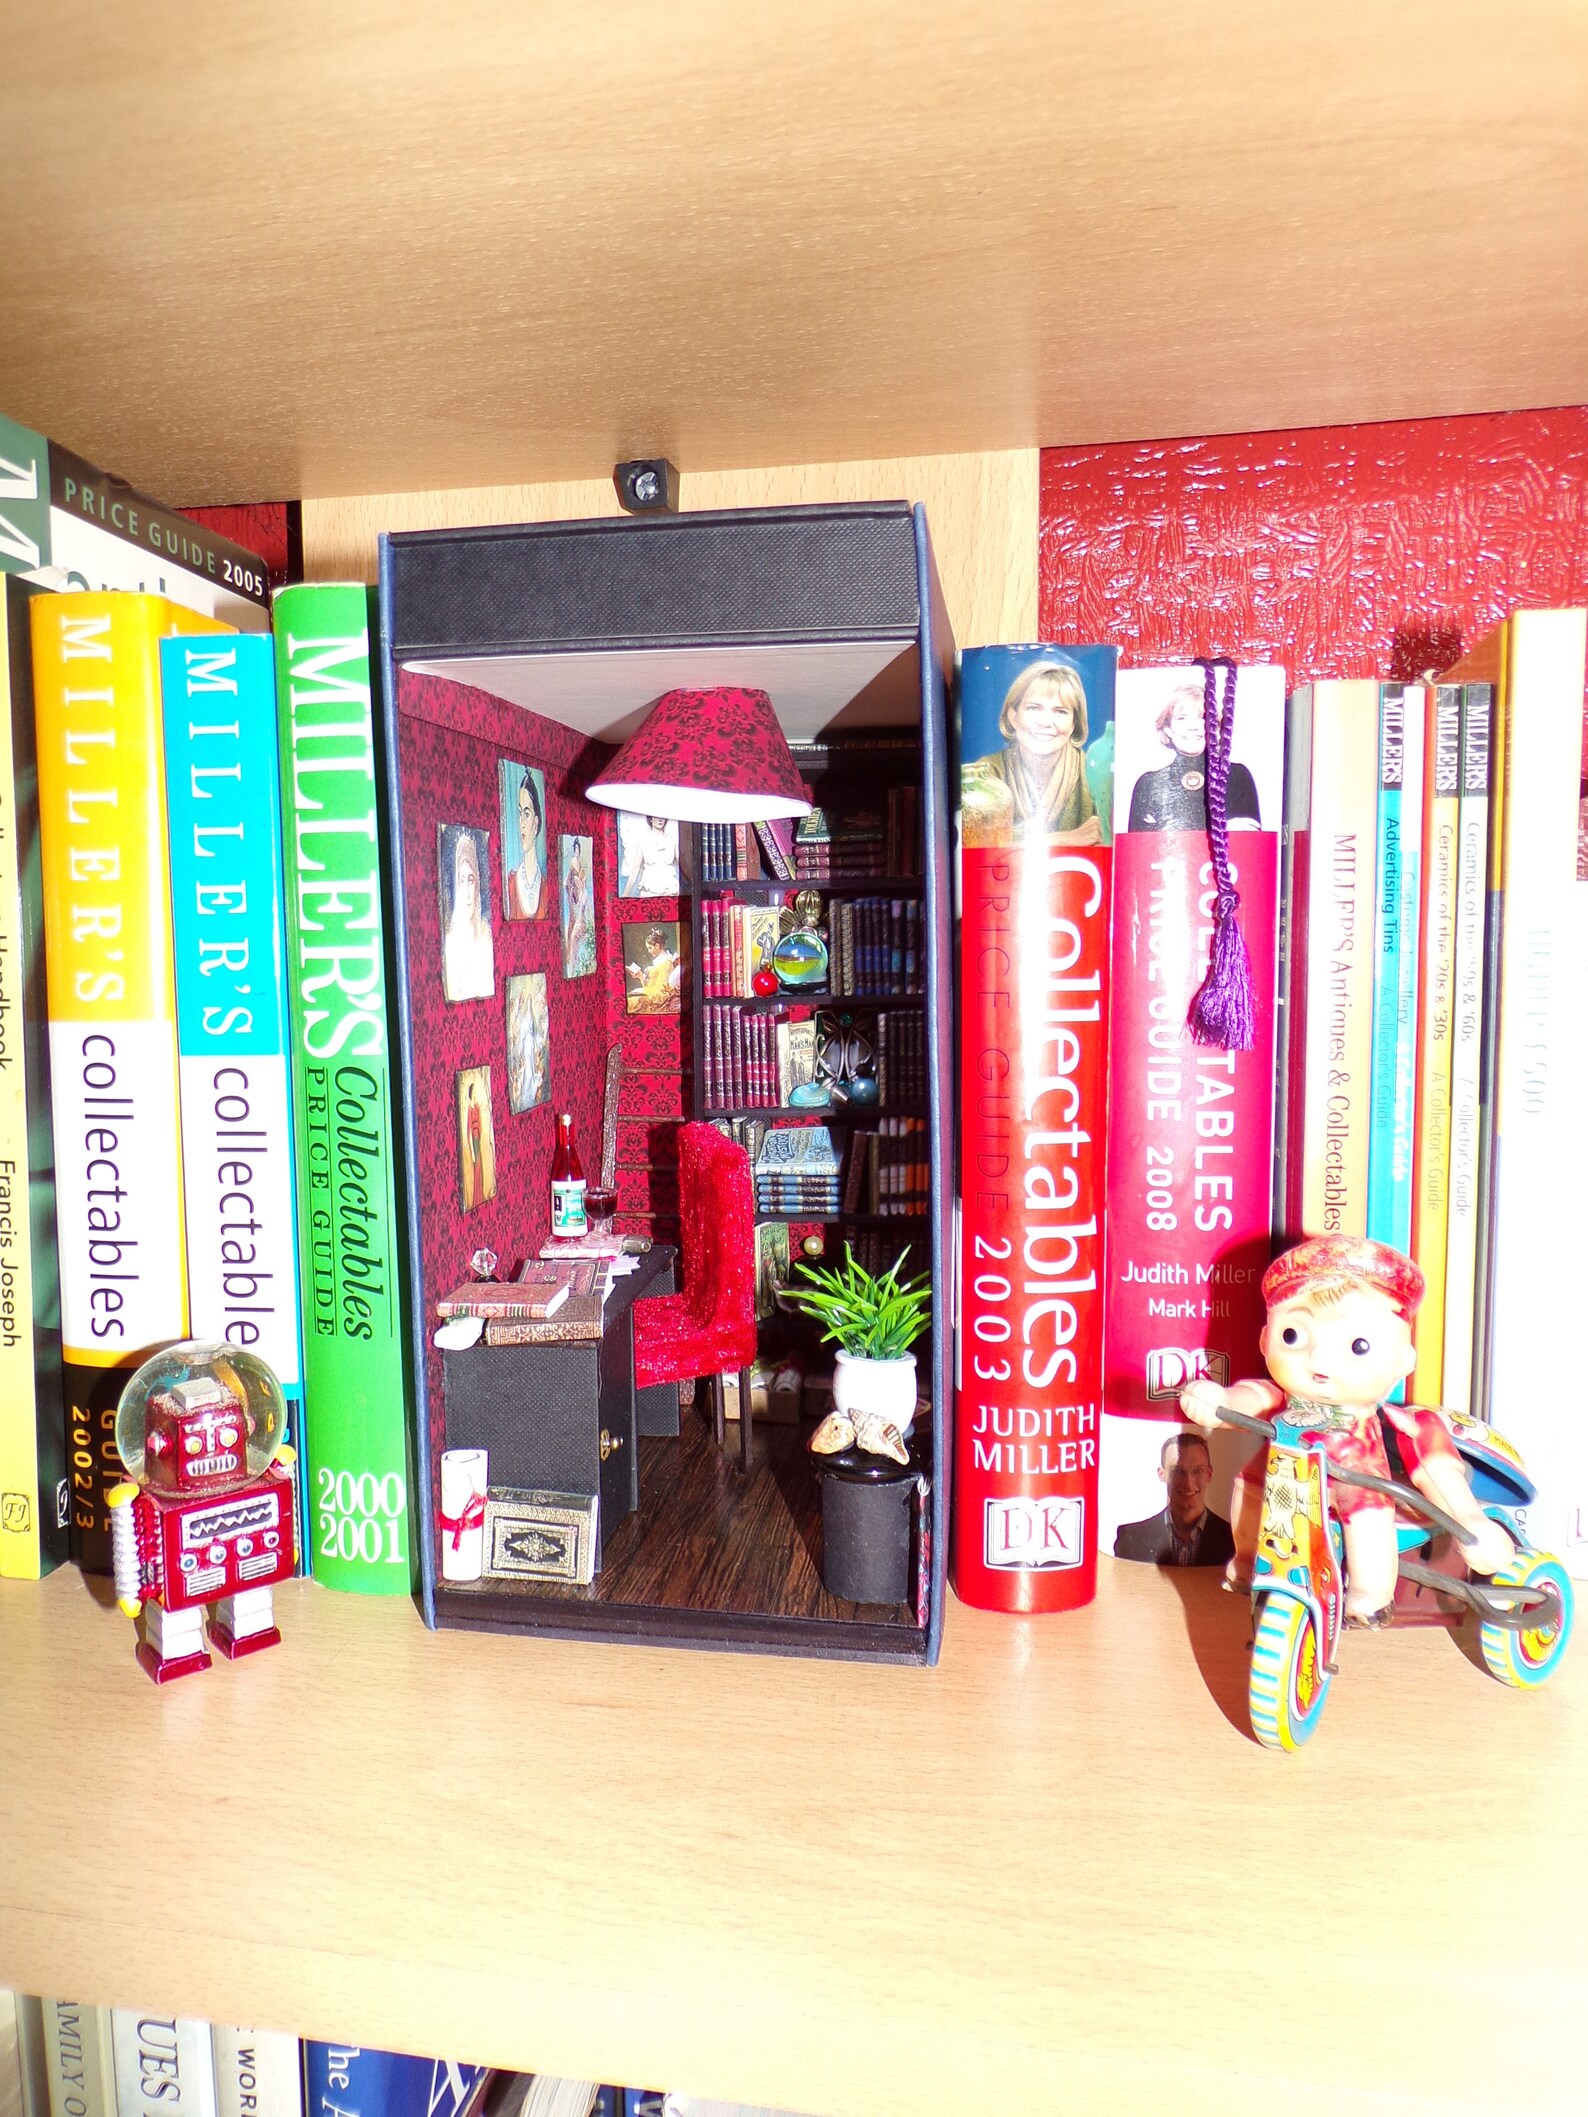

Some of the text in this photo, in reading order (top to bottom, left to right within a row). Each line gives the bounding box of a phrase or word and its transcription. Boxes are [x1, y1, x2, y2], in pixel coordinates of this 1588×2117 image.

[65, 478, 139, 536] PRICE
[148, 521, 217, 575] GUIDE
[222, 559, 264, 597] 2005
[1382, 696, 1405, 784] MILLER'S
[1436, 705, 1459, 790] MILLER'S
[1465, 705, 1490, 790] MILLER'S
[61, 613, 126, 1003] MILLER'S
[185, 646, 254, 1036] MILLER'S
[287, 627, 384, 1060] MILLER'S
[1381, 817, 1400, 954] Advertising Tins
[1438, 824, 1454, 899] Ceramics
[1465, 822, 1481, 896] Ceramics
[1397, 871, 1416, 1026] Costume Jewellery
[1437, 927, 1453, 954] the
[1439, 903, 1454, 922] of
[1464, 900, 1478, 918] of
[0, 933, 12, 1071] Hdbook
[1436, 959, 1450, 991] '20s
[1462, 993, 1477, 1005] &
[1146, 994, 1182, 1122] GUIDE
[1194, 858, 1240, 1232] COLLTABLES
[1323, 833, 1357, 1232] MILLER'S Antiques & Collectables
[1375, 986, 1395, 1130] A Collector's Guide
[1433, 1009, 1449, 1041] '30s
[1461, 1010, 1476, 1042] '60s
[973, 864, 1013, 1382] PRICE GUIDE 2003
[1021, 854, 1103, 1390] Collectables
[1427, 1072, 1447, 1211] A Collector's Guide
[1456, 1092, 1474, 1169] Collector's
[82, 1034, 140, 1338] collectables
[306, 1068, 335, 1335] PRICE GUIDE
[334, 1066, 383, 1342] Collectables
[1146, 1146, 1179, 1232] 2008
[1455, 1174, 1472, 1217] Guide
[0, 1161, 22, 1347] Francis Joseph
[1120, 1261, 1257, 1286] Judith Miller
[1148, 1297, 1232, 1319] Mark Hill
[1156, 1352, 1219, 1392] DK
[972, 1404, 1096, 1438] JUDITH
[972, 1439, 1096, 1475] MILLER
[71, 1406, 95, 1530] 2002/3
[317, 1467, 406, 1518] 2000
[319, 1515, 406, 1563] 2001
[999, 1506, 1071, 1552] DK
[236, 2048, 257, 2117] WOR
[328, 2047, 361, 2090] he
